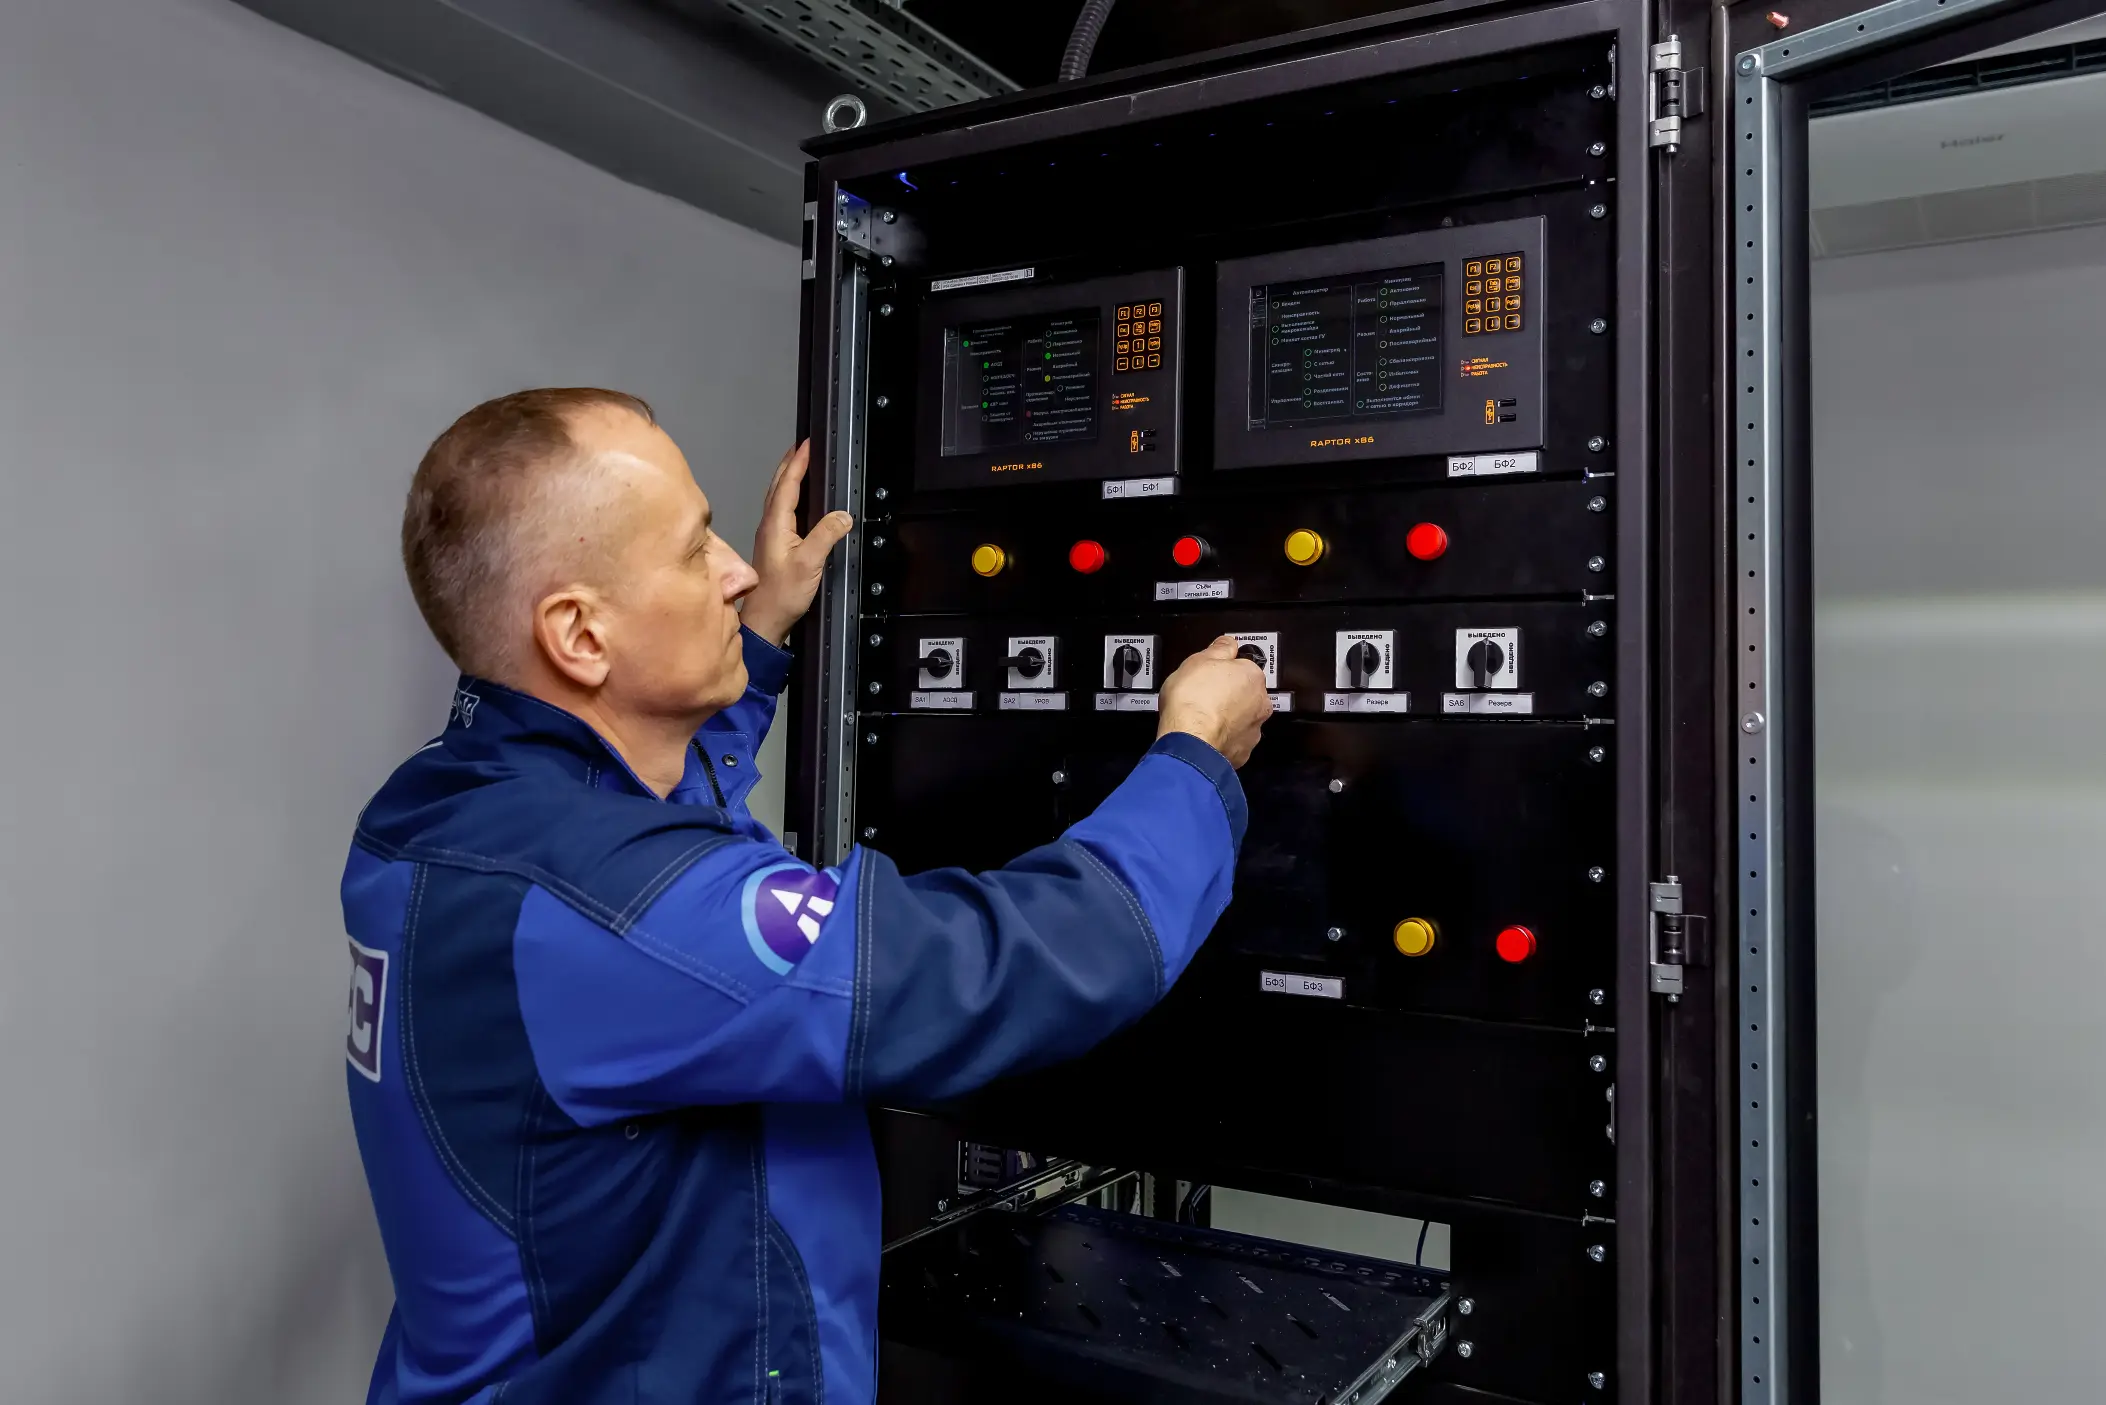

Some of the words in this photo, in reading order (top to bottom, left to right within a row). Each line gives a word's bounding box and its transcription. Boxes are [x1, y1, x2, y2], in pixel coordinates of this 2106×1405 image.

[1311, 438, 1350, 447] RAPTOR
[1452, 462, 1473, 471] БФ2
[1494, 459, 1516, 468] БФ2
[1106, 486, 1123, 494] БФ1
[1142, 483, 1159, 491] БФ1
[1265, 978, 1284, 987] БФ3
[1304, 981, 1323, 991] БФ3
